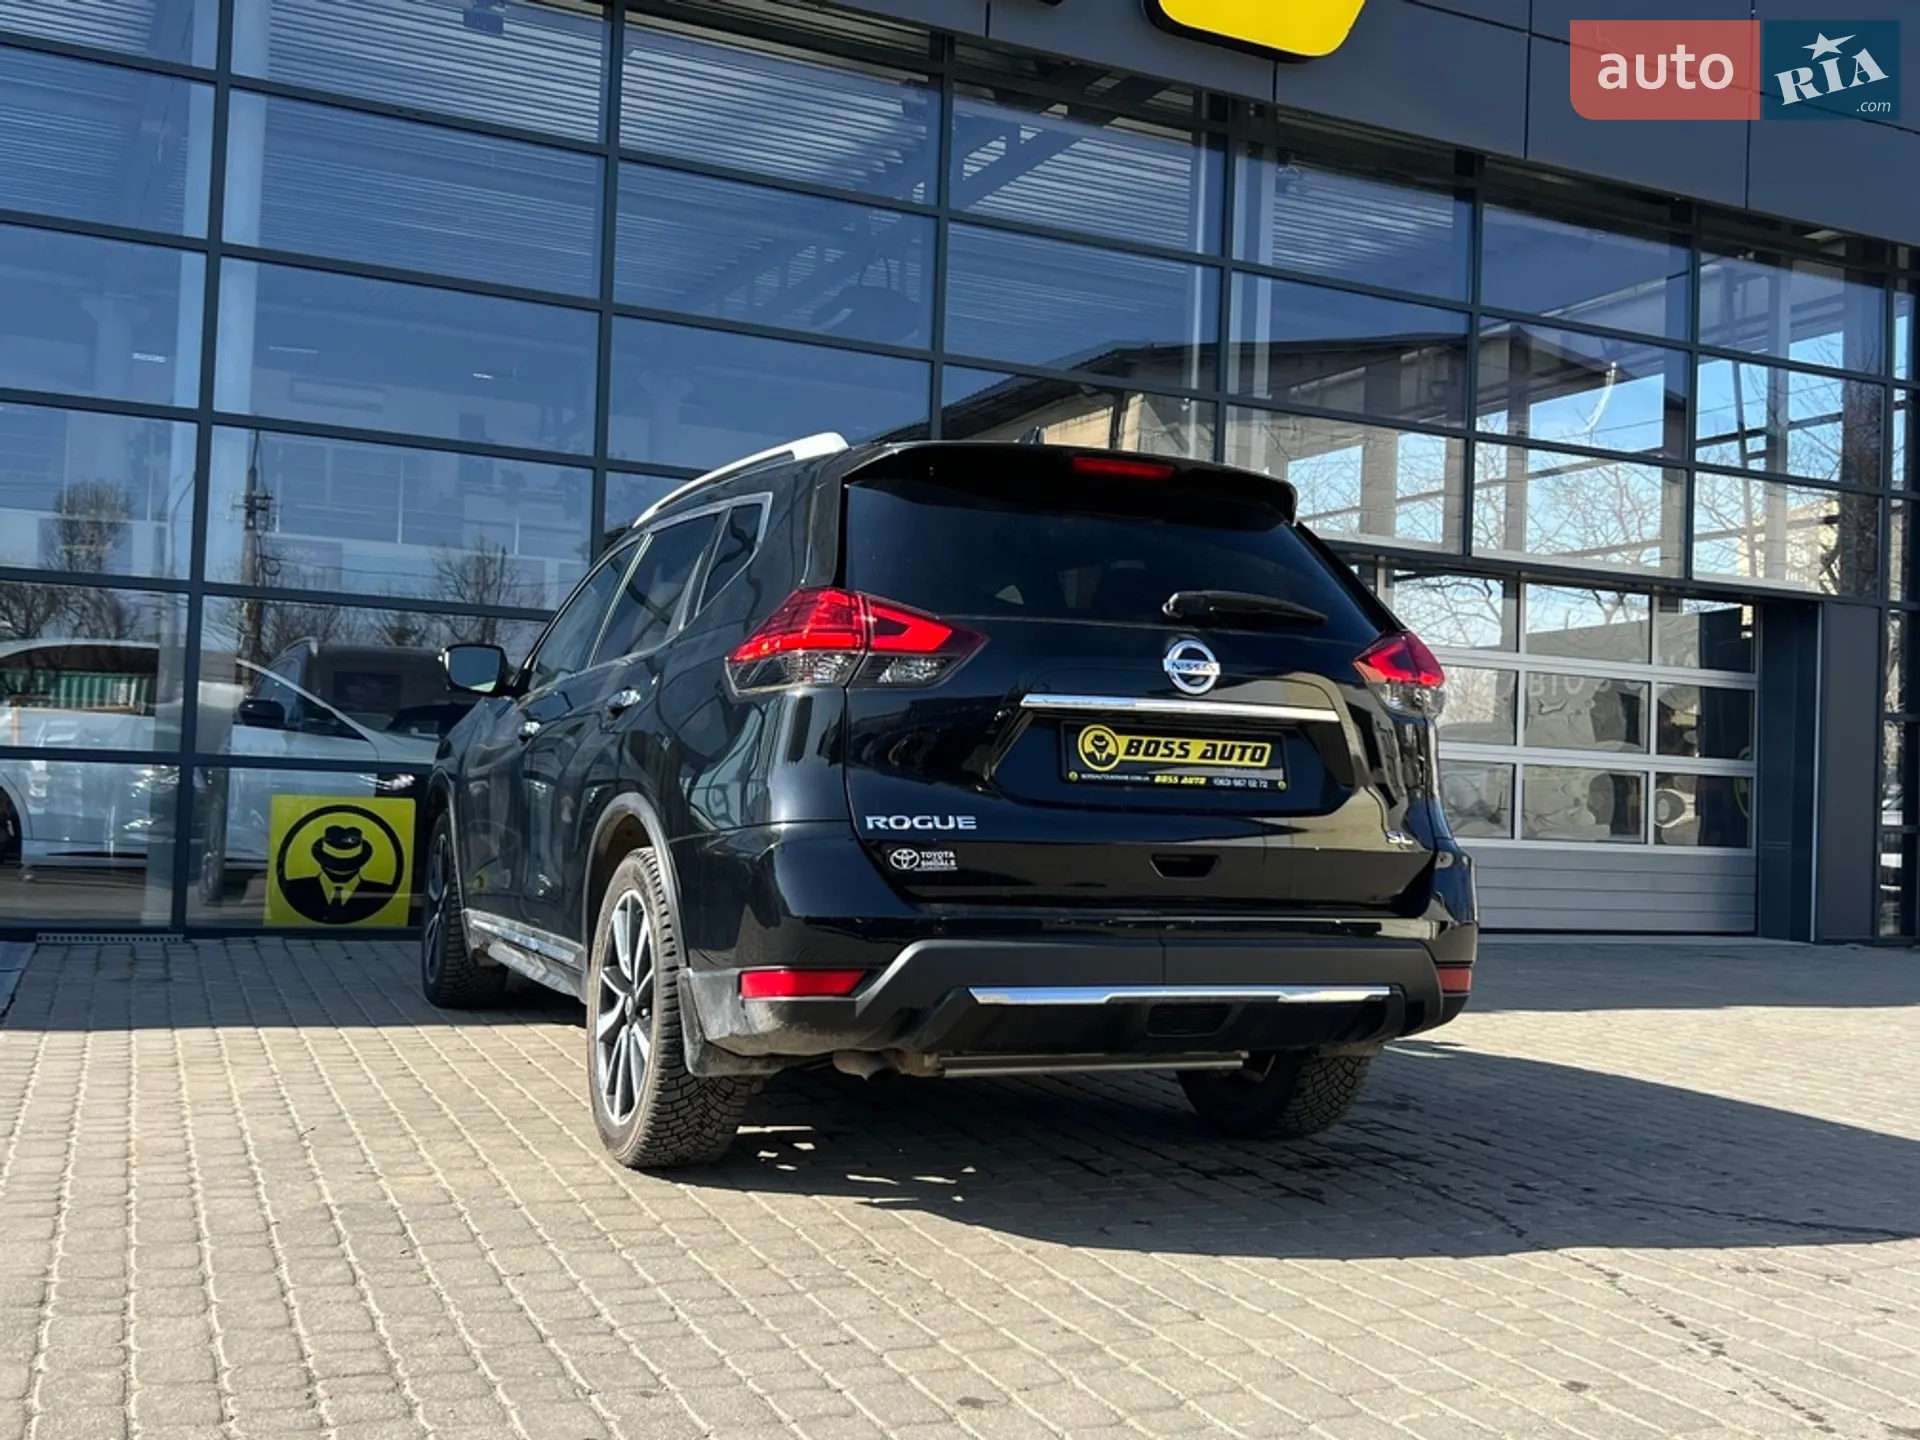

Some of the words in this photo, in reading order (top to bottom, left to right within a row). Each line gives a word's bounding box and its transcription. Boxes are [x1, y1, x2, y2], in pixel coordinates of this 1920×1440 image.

[1171, 662, 1215, 671] NISSAN
[1125, 739, 1190, 758] BOSS
[1199, 743, 1267, 762] AUTO
[1154, 775, 1179, 784] BOSS
[1181, 776, 1206, 785] AUTO
[865, 815, 977, 830] ROGUE
[1387, 831, 1413, 844] SL
